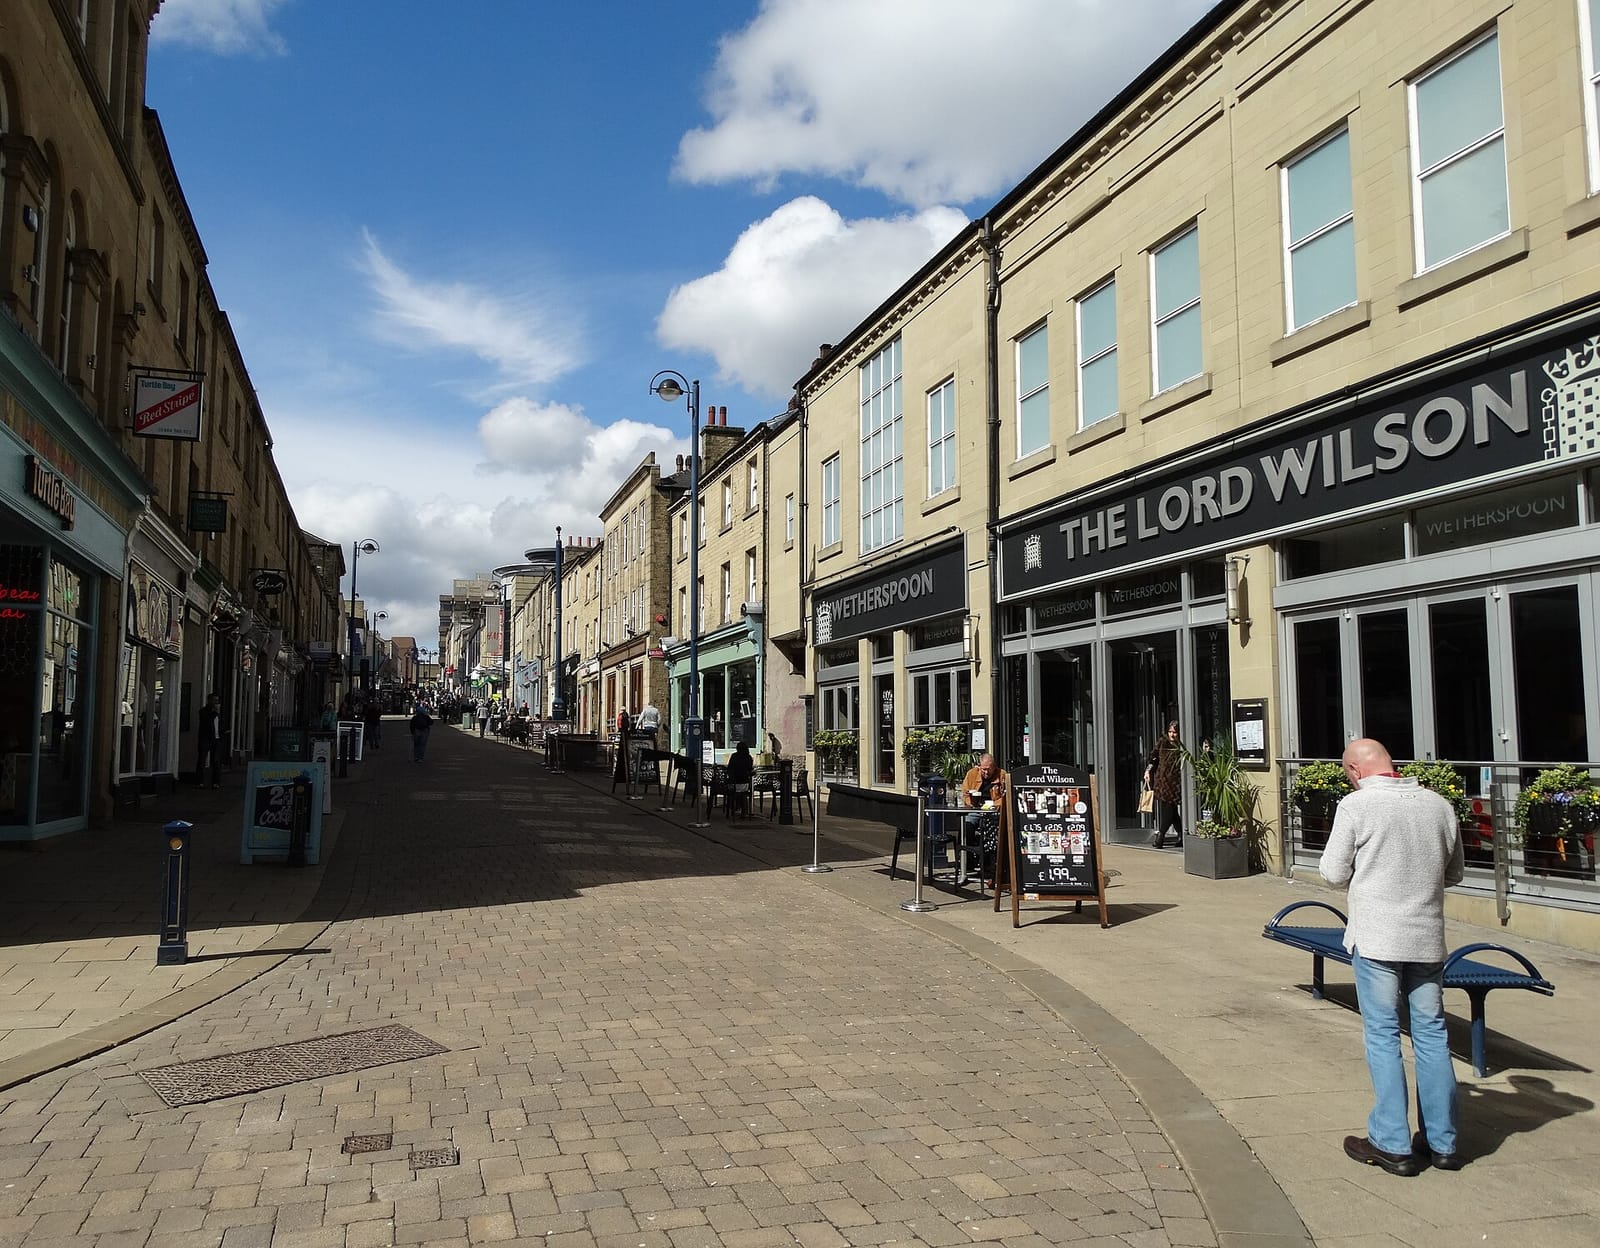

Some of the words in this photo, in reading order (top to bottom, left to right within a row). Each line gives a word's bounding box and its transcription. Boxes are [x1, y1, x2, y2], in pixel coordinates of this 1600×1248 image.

[139, 406, 162, 425] Red
[163, 391, 195, 411] Stripe
[1059, 503, 1128, 561] THE
[1136, 465, 1254, 541] LORD
[1258, 371, 1530, 502] WILSON
[33, 456, 60, 512] Turtle
[60, 482, 76, 530] Bay
[1427, 495, 1566, 537] WETHERSPOON
[831, 568, 934, 621] WETHERSPOON
[1038, 599, 1094, 618] WETHERSPOON
[1111, 580, 1179, 603] WETHERSPOON
[1026, 775, 1046, 783] Lord
[1047, 775, 1075, 784] Wilson
[1041, 766, 1058, 775] The
